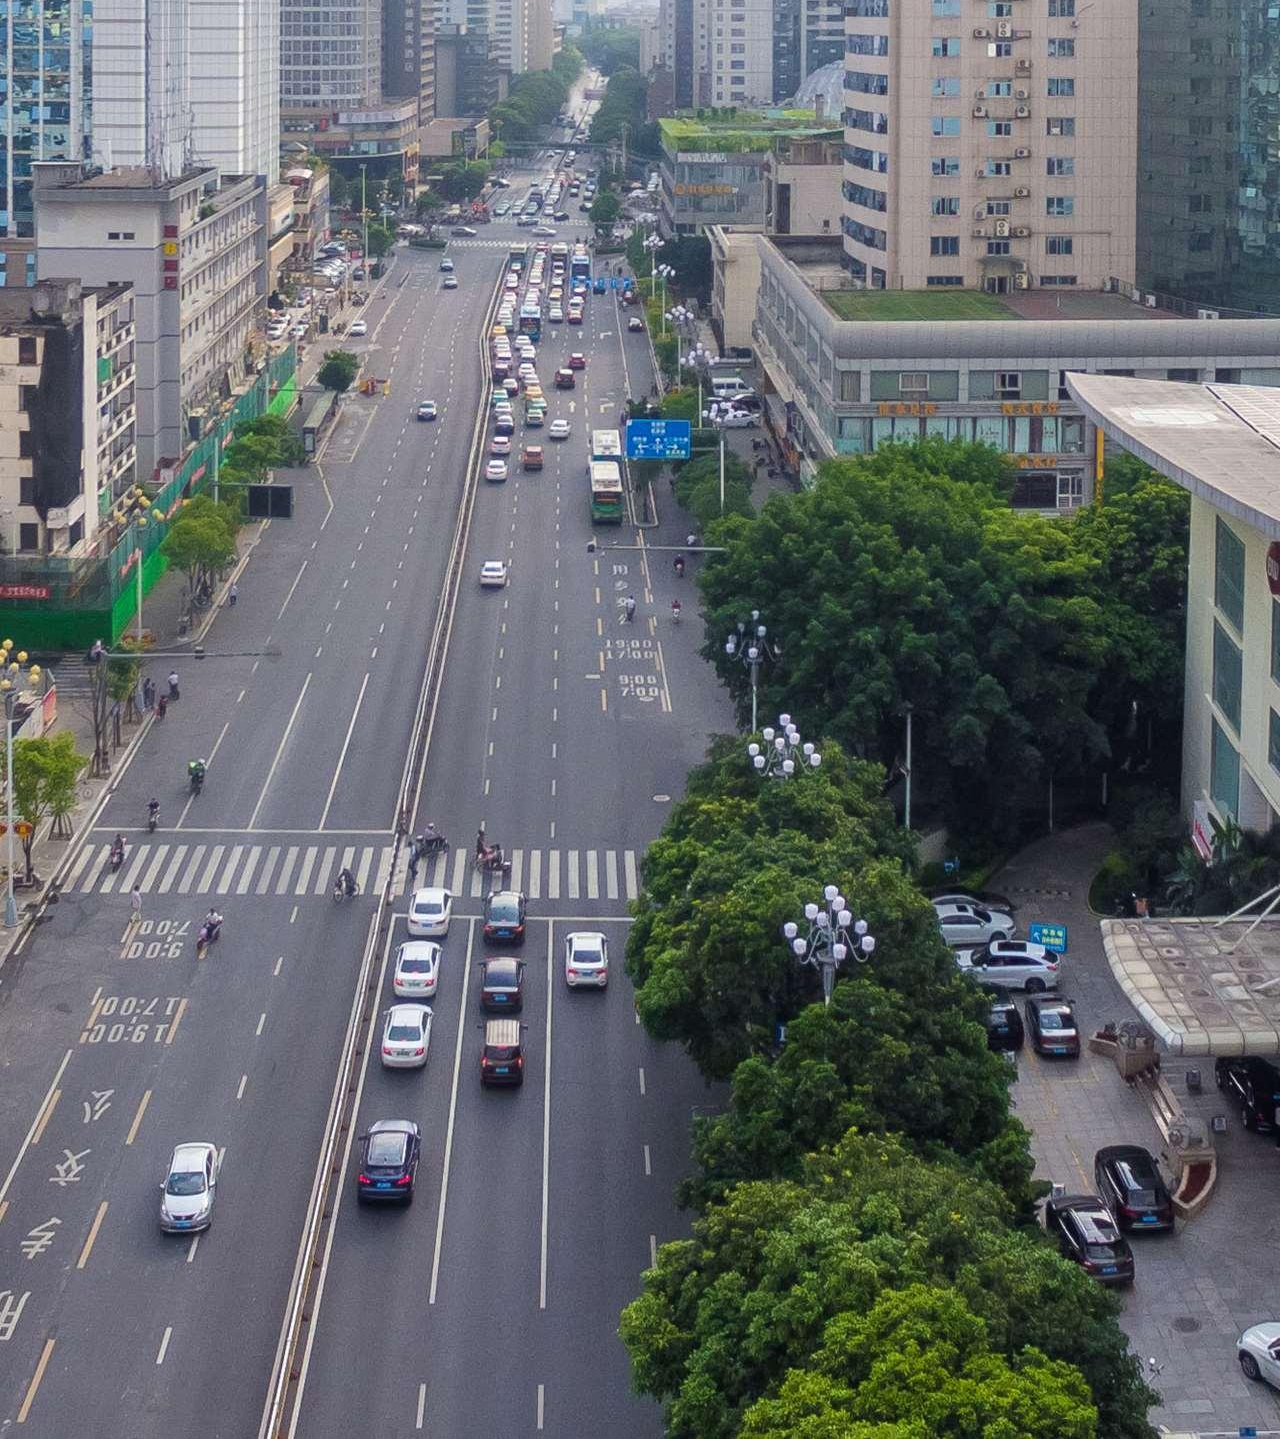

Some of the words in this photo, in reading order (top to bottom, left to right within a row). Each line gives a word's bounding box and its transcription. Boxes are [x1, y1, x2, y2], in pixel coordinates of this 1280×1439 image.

[139, 920, 192, 936] 7:00
[127, 941, 184, 959] 9:00
[101, 997, 180, 1016] 17:00
[88, 1023, 170, 1043] 19:00
